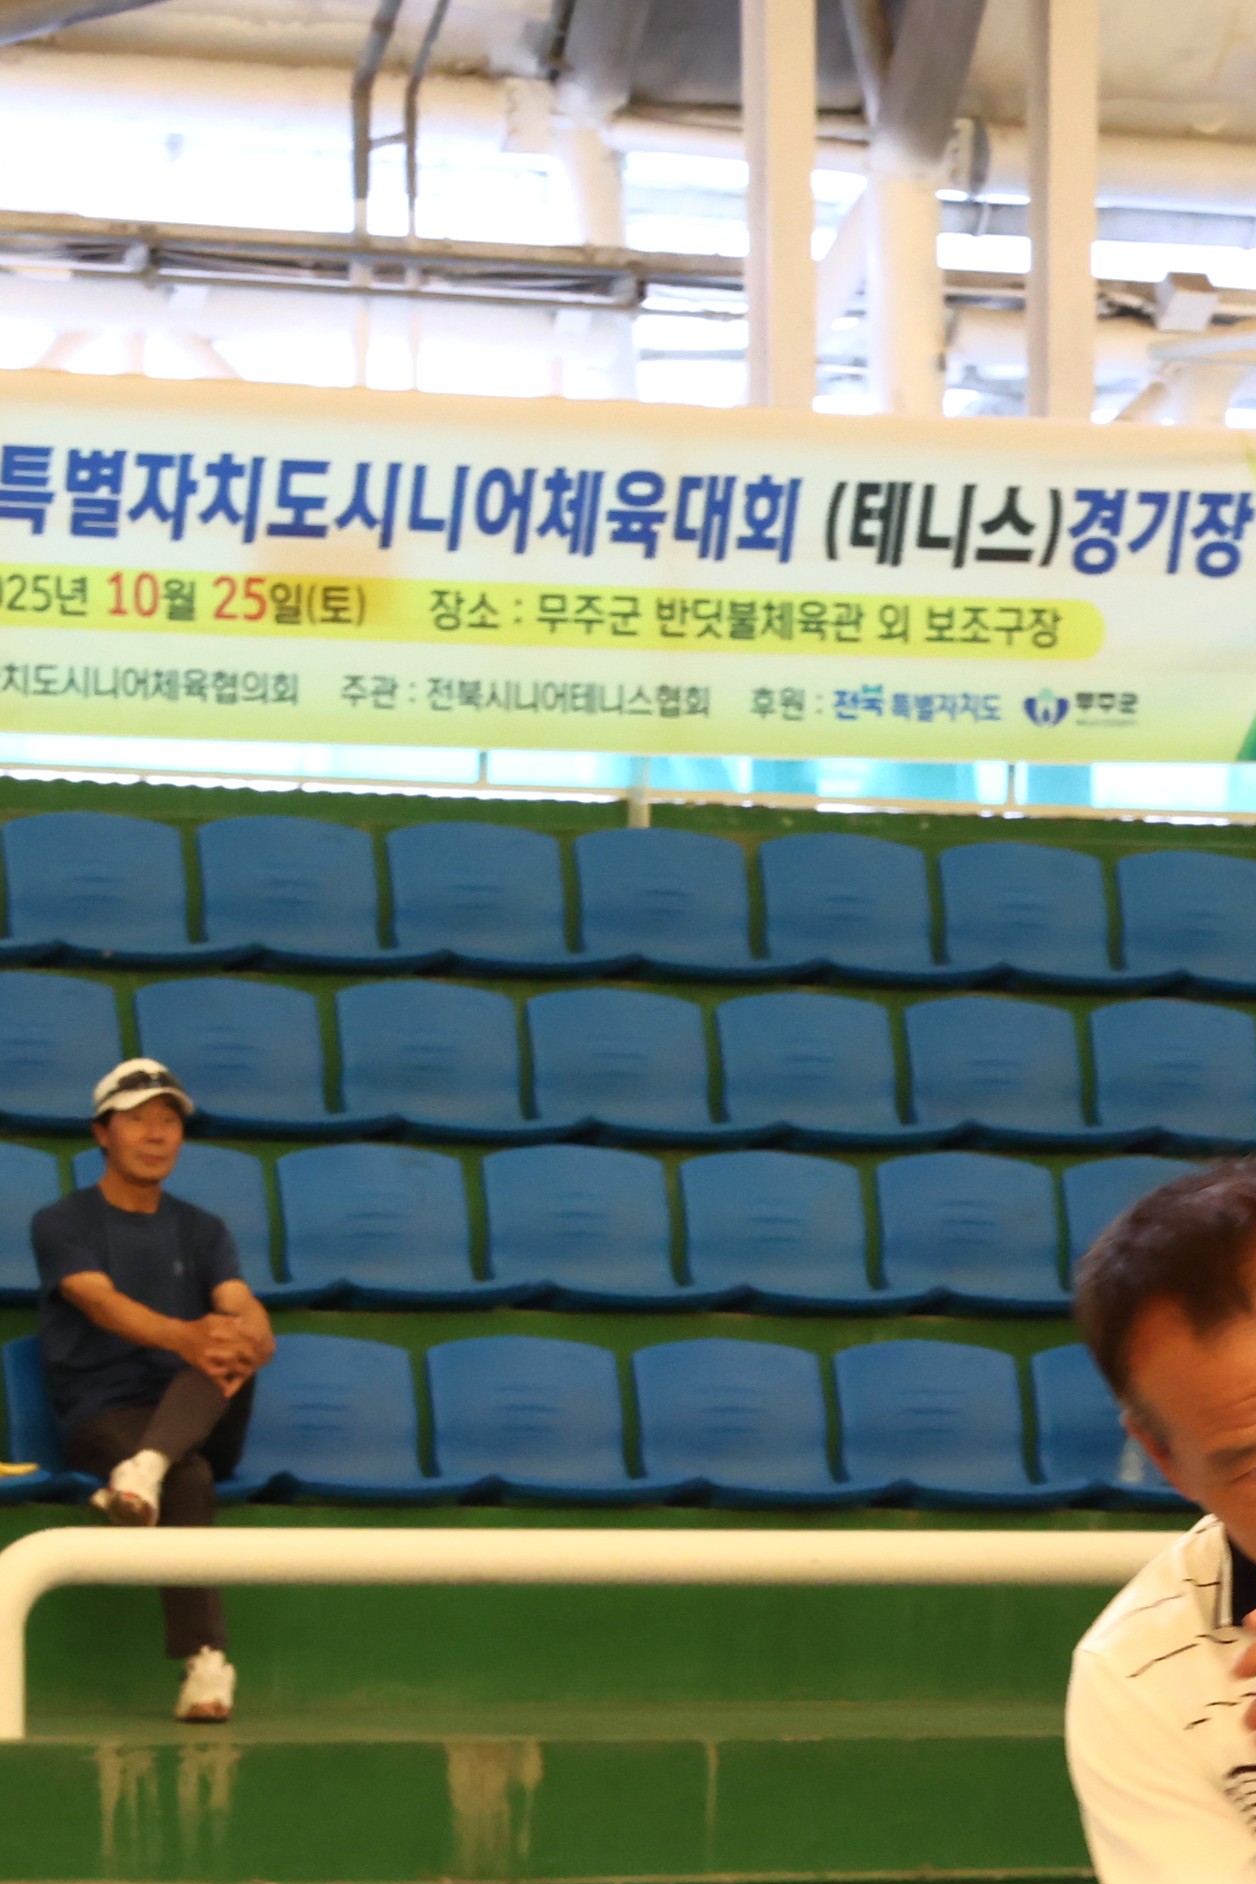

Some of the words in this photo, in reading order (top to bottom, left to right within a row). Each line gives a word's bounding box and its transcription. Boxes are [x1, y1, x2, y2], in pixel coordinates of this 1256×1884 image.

[0, 444, 801, 564] 특별자치도시니어체육대회
[825, 480, 1255, 579] (테니스)경기장
[0, 573, 88, 617] 25년
[106, 571, 196, 622] 10월
[212, 575, 366, 627] 25일(토)
[430, 588, 499, 631] 장소
[537, 593, 642, 637] 무주군
[655, 596, 865, 643] 반딧불체육관
[878, 602, 910, 643] 외
[925, 605, 1063, 650] 보조구장
